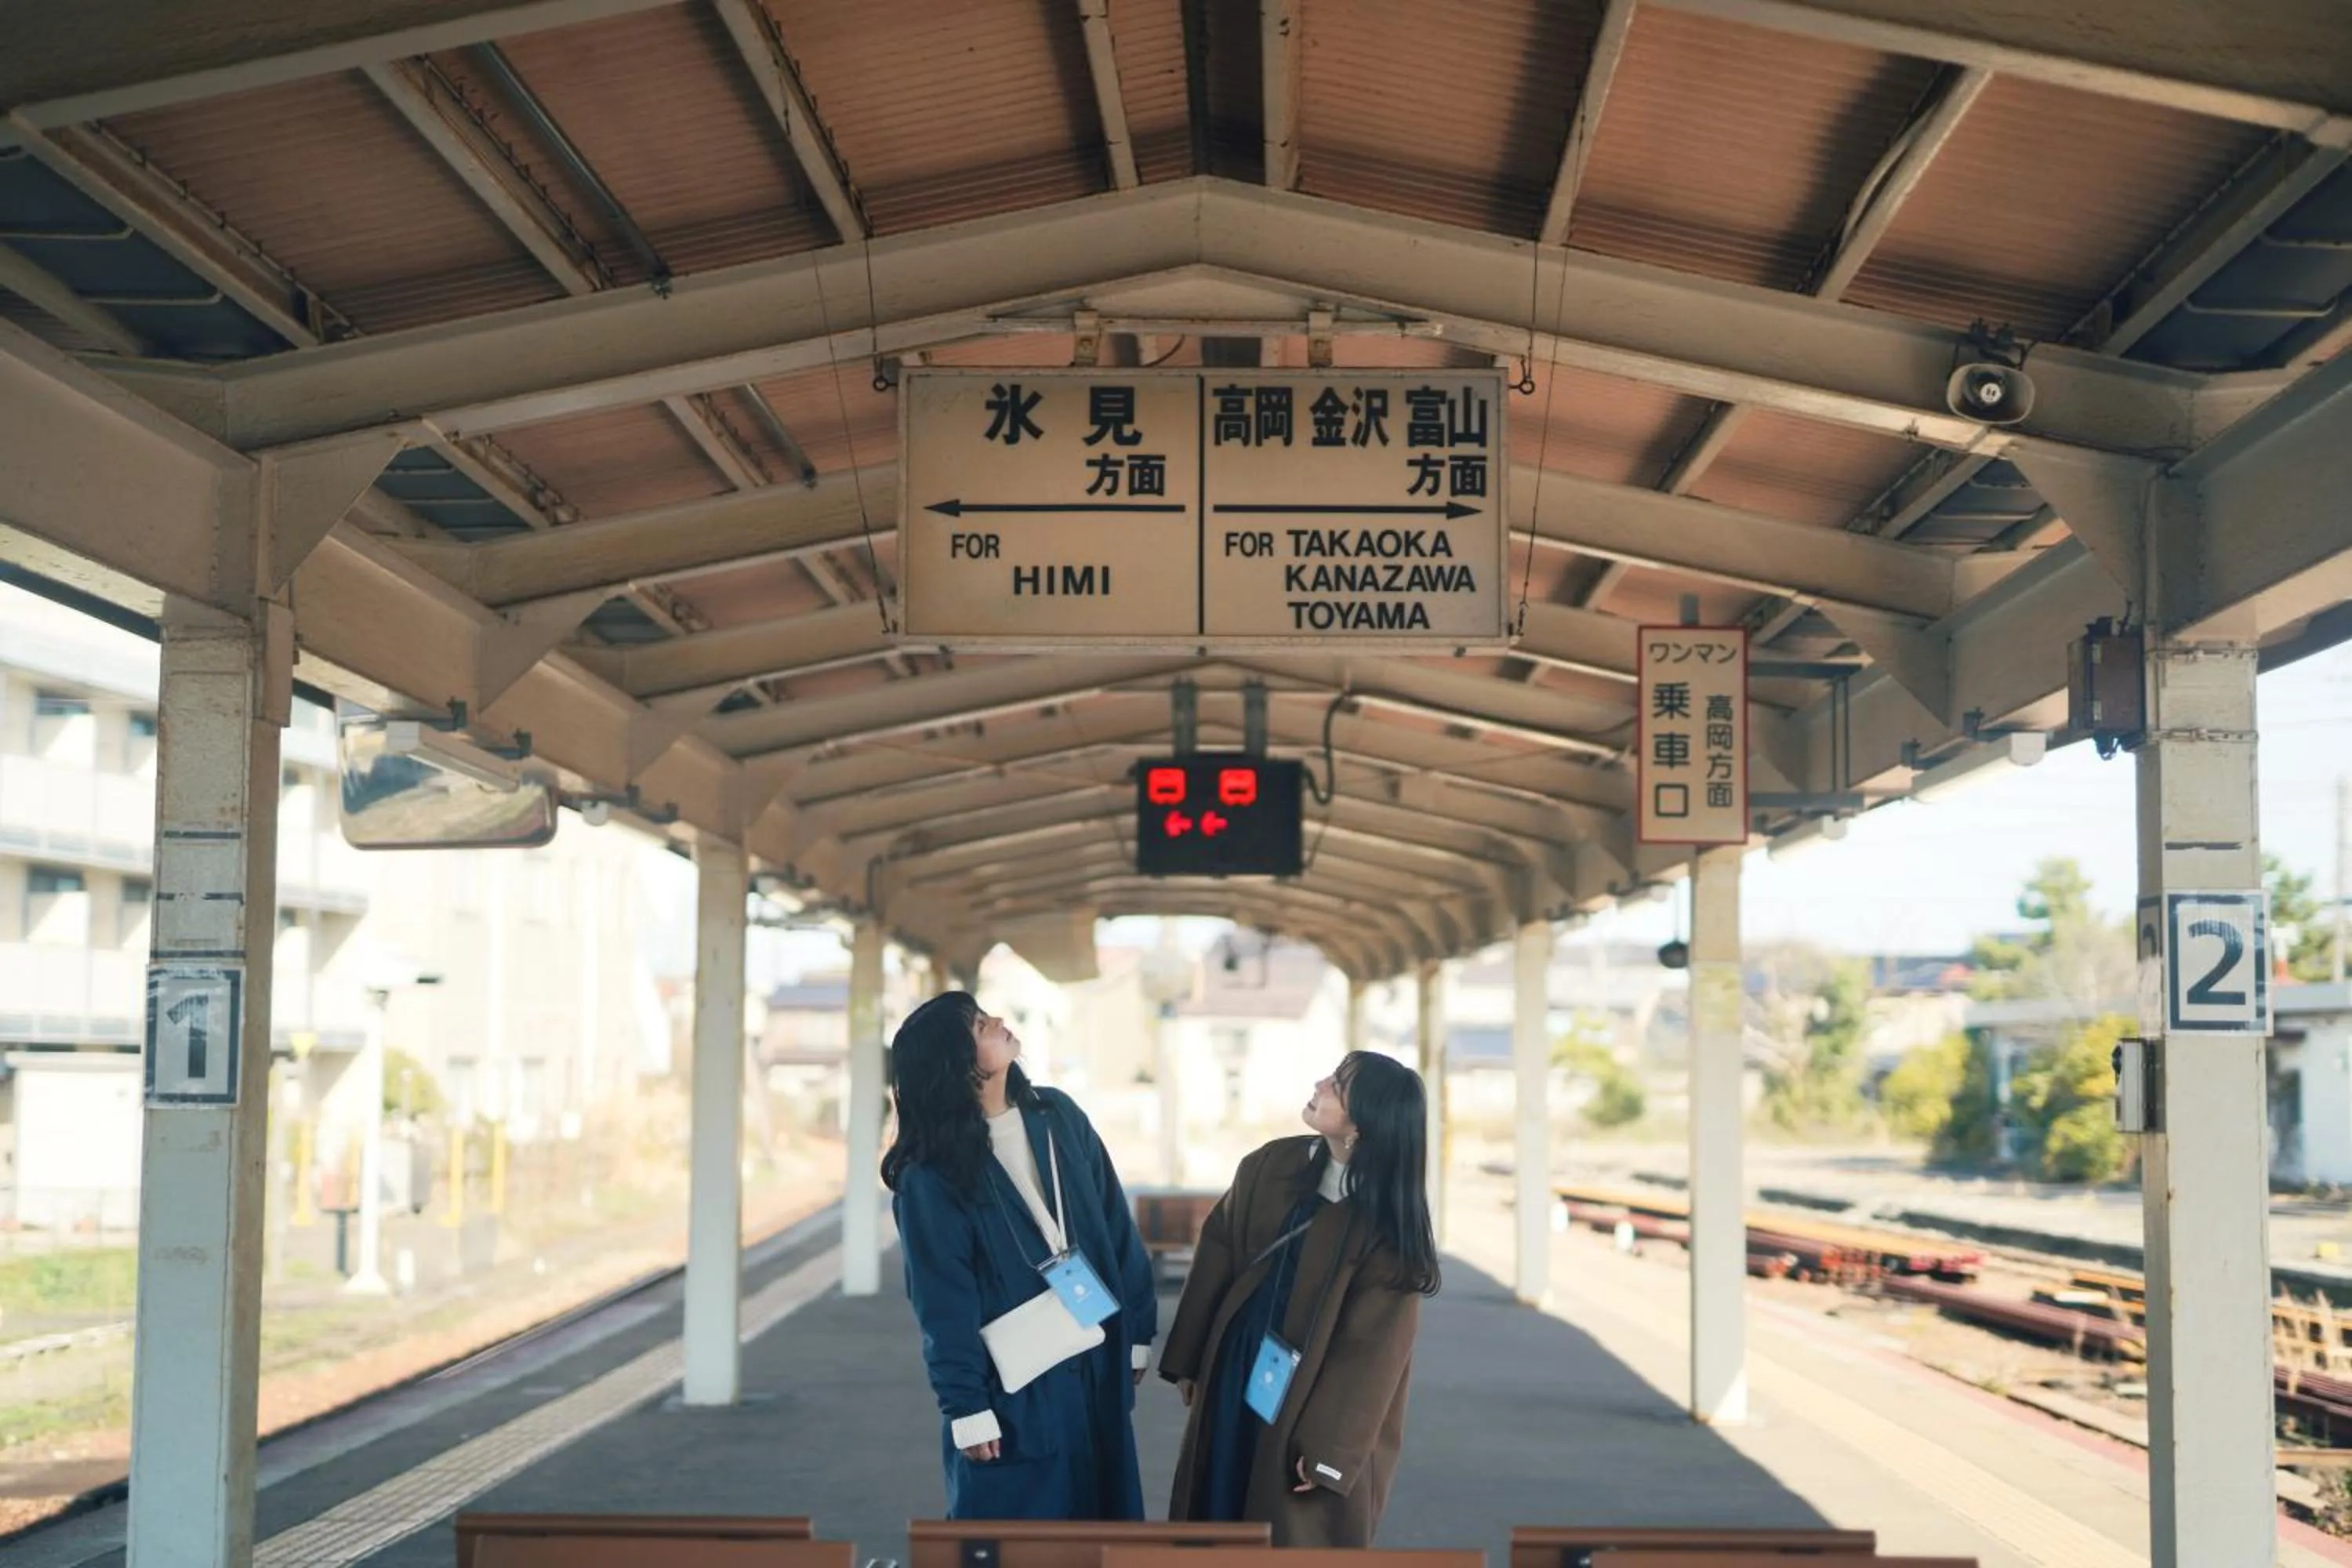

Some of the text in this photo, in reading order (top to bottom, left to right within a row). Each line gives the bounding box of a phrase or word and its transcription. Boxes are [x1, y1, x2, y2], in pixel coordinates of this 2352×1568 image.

[984, 383, 1142, 446] 氷見
[1212, 383, 1488, 448] 高岡 金沢 富山
[1085, 453, 1167, 497] 方面
[1406, 453, 1489, 498] 方面
[950, 532, 1000, 559] FOR
[1225, 529, 1453, 558] FOR TAKAOKA
[1012, 564, 1111, 596] HIMI
[1285, 564, 1476, 593] KANAZAWA
[1287, 601, 1431, 630] TOYAMA
[1649, 641, 1738, 664] ワンマン
[1652, 681, 1691, 818] 乗車口
[1705, 693, 1734, 808] 高岡方面
[2186, 919, 2246, 1005] 2
[166, 994, 209, 1078] 1
